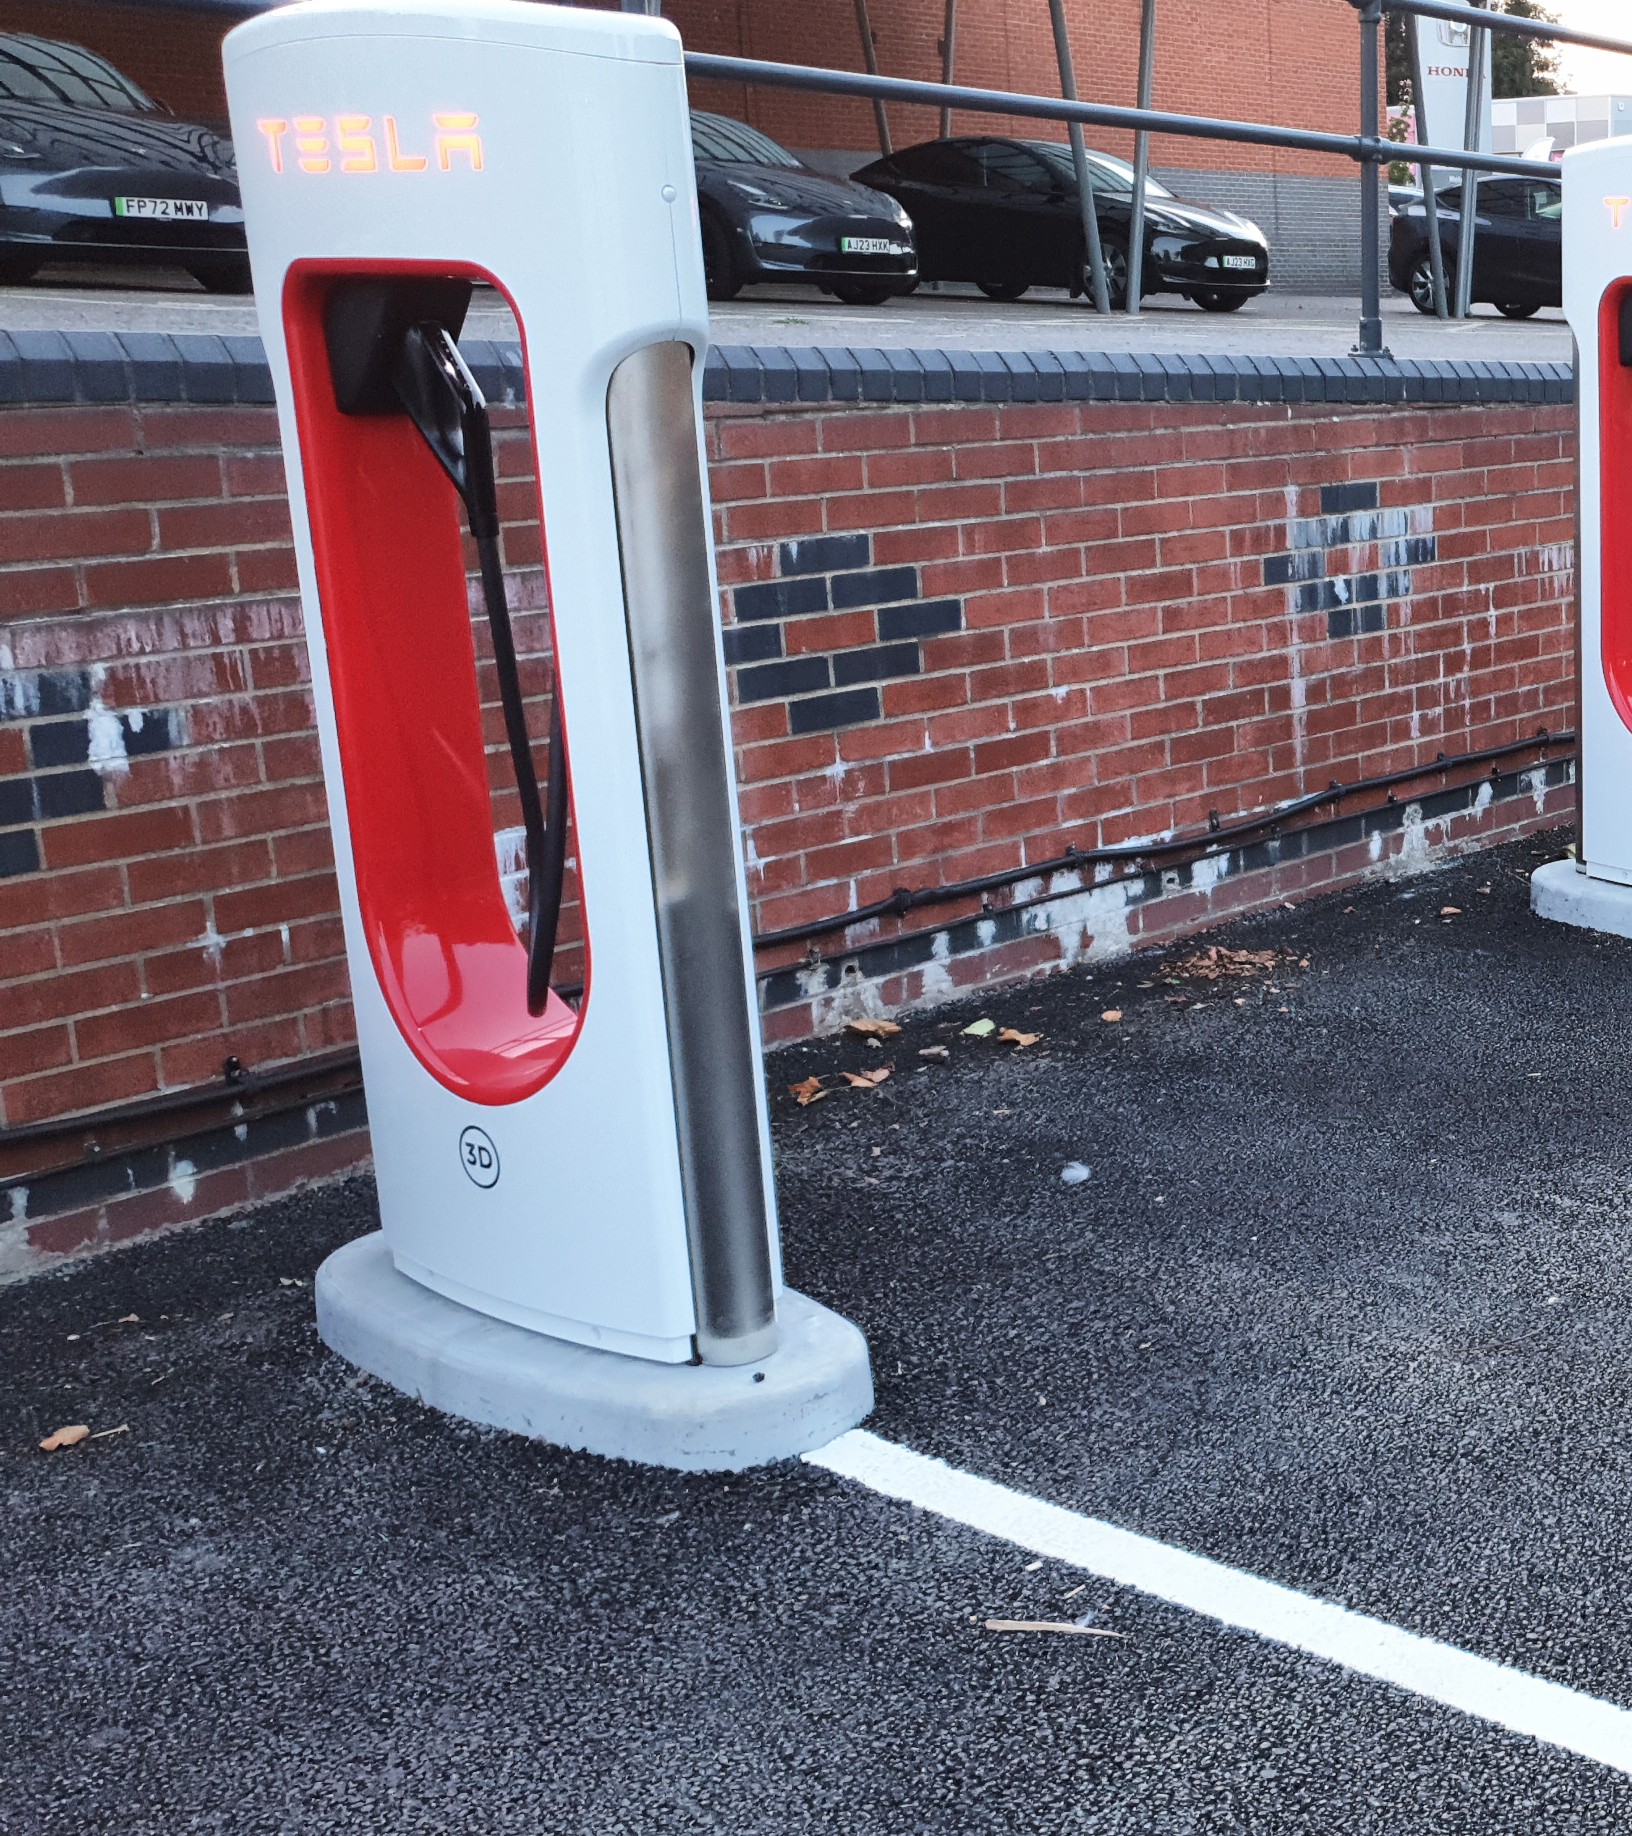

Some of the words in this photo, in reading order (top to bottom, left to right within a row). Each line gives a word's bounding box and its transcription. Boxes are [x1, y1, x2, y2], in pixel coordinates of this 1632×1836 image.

[256, 112, 485, 174] TESLA
[126, 198, 170, 216] FP72
[173, 201, 205, 217] MWY
[847, 239, 870, 251] AJ23
[464, 1141, 493, 1169] 3D
